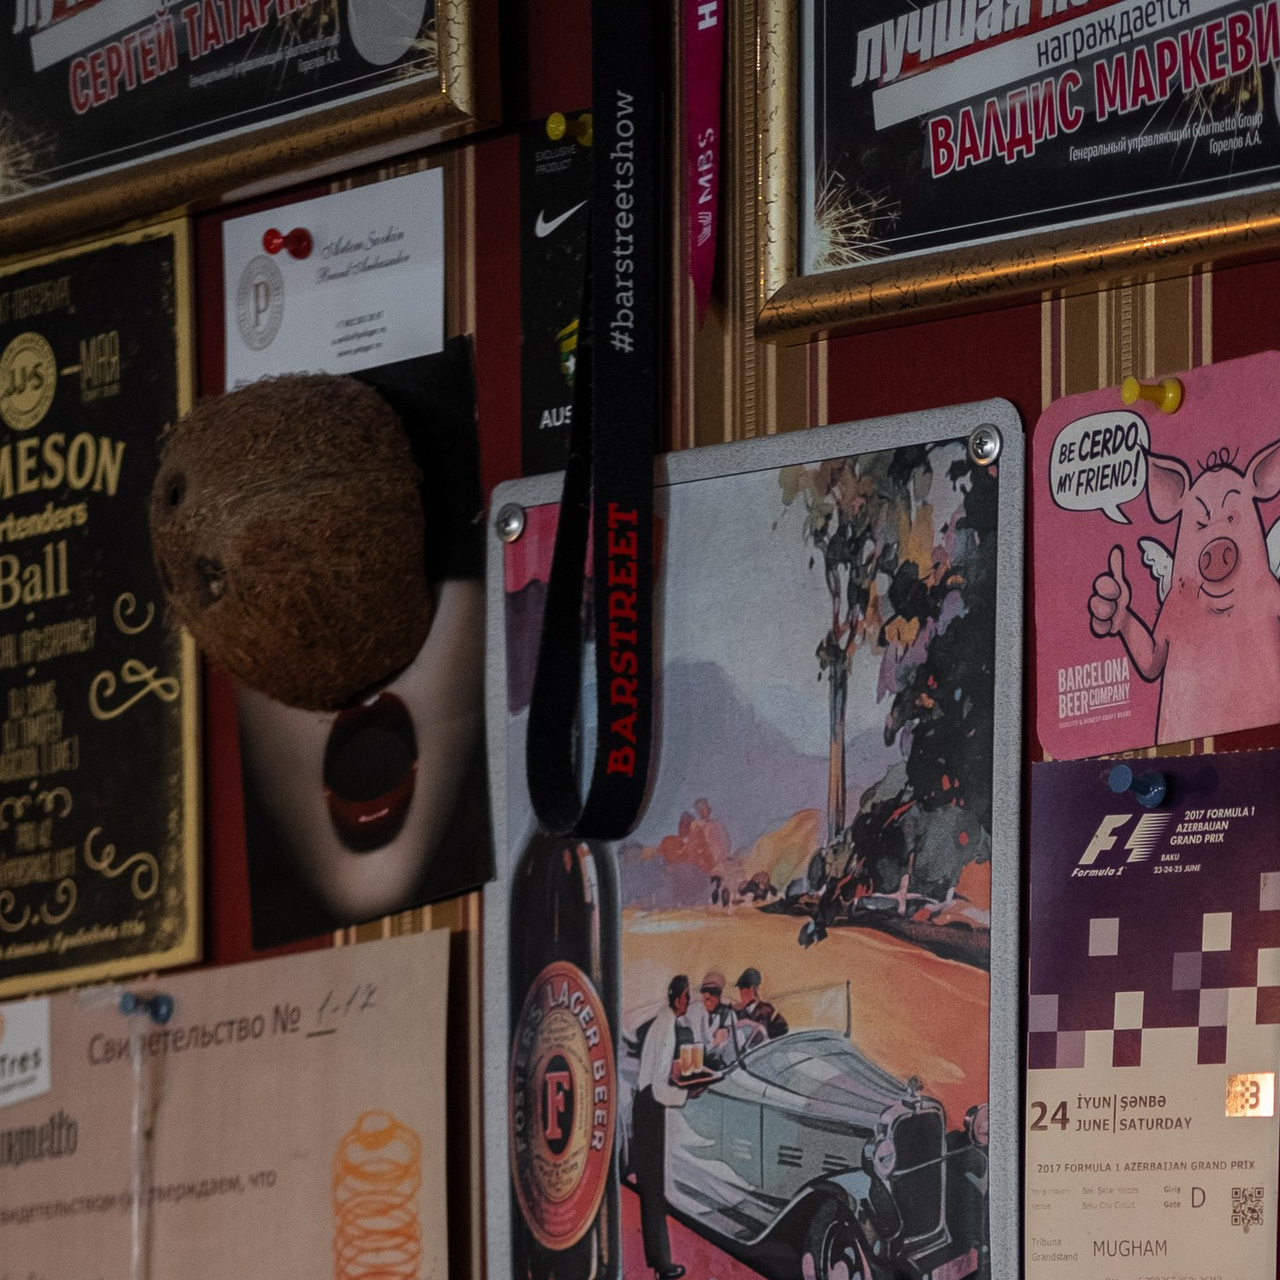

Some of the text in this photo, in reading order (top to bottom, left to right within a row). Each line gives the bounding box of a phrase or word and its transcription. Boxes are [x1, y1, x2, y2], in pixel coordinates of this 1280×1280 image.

[1036, 0, 1191, 67] награждается
[69, 10, 178, 115] СЕРГЕЙ
[929, 70, 1084, 179] ВАЛДИС
[1068, 129, 1191, 162] Генеральный управляющий
[1209, 136, 1244, 156] Горелов
[609, 89, 635, 353] #barstreetshow
[1058, 421, 1140, 466] BE CERDO
[1056, 448, 1141, 497] MY FRIEND!
[606, 502, 639, 778] BARSTREET
[1057, 656, 1131, 693] BARCELONA
[1057, 681, 1131, 719] BEER COMPANY
[1183, 806, 1249, 821] 2017 FORMULA
[1175, 820, 1230, 834] AZERBAIJAN
[1170, 832, 1225, 847] GRAND PRIX
[1160, 852, 1181, 863] BAKU
[1183, 863, 1202, 874] JUNE
[1070, 865, 1113, 879] Formula
[1029, 1100, 1071, 1132] 24
[1075, 1116, 1193, 1133] JUNE SATURDAY
[1037, 1159, 1256, 1174] 2017 FORMULA AZERBAIJAN GRAND PRIX
[1191, 1186, 1207, 1210] D
[1031, 1236, 1062, 1247] Tribuna
[1092, 1239, 1169, 1258] MUGHAM
[1031, 1251, 1079, 1263] Grandstand
